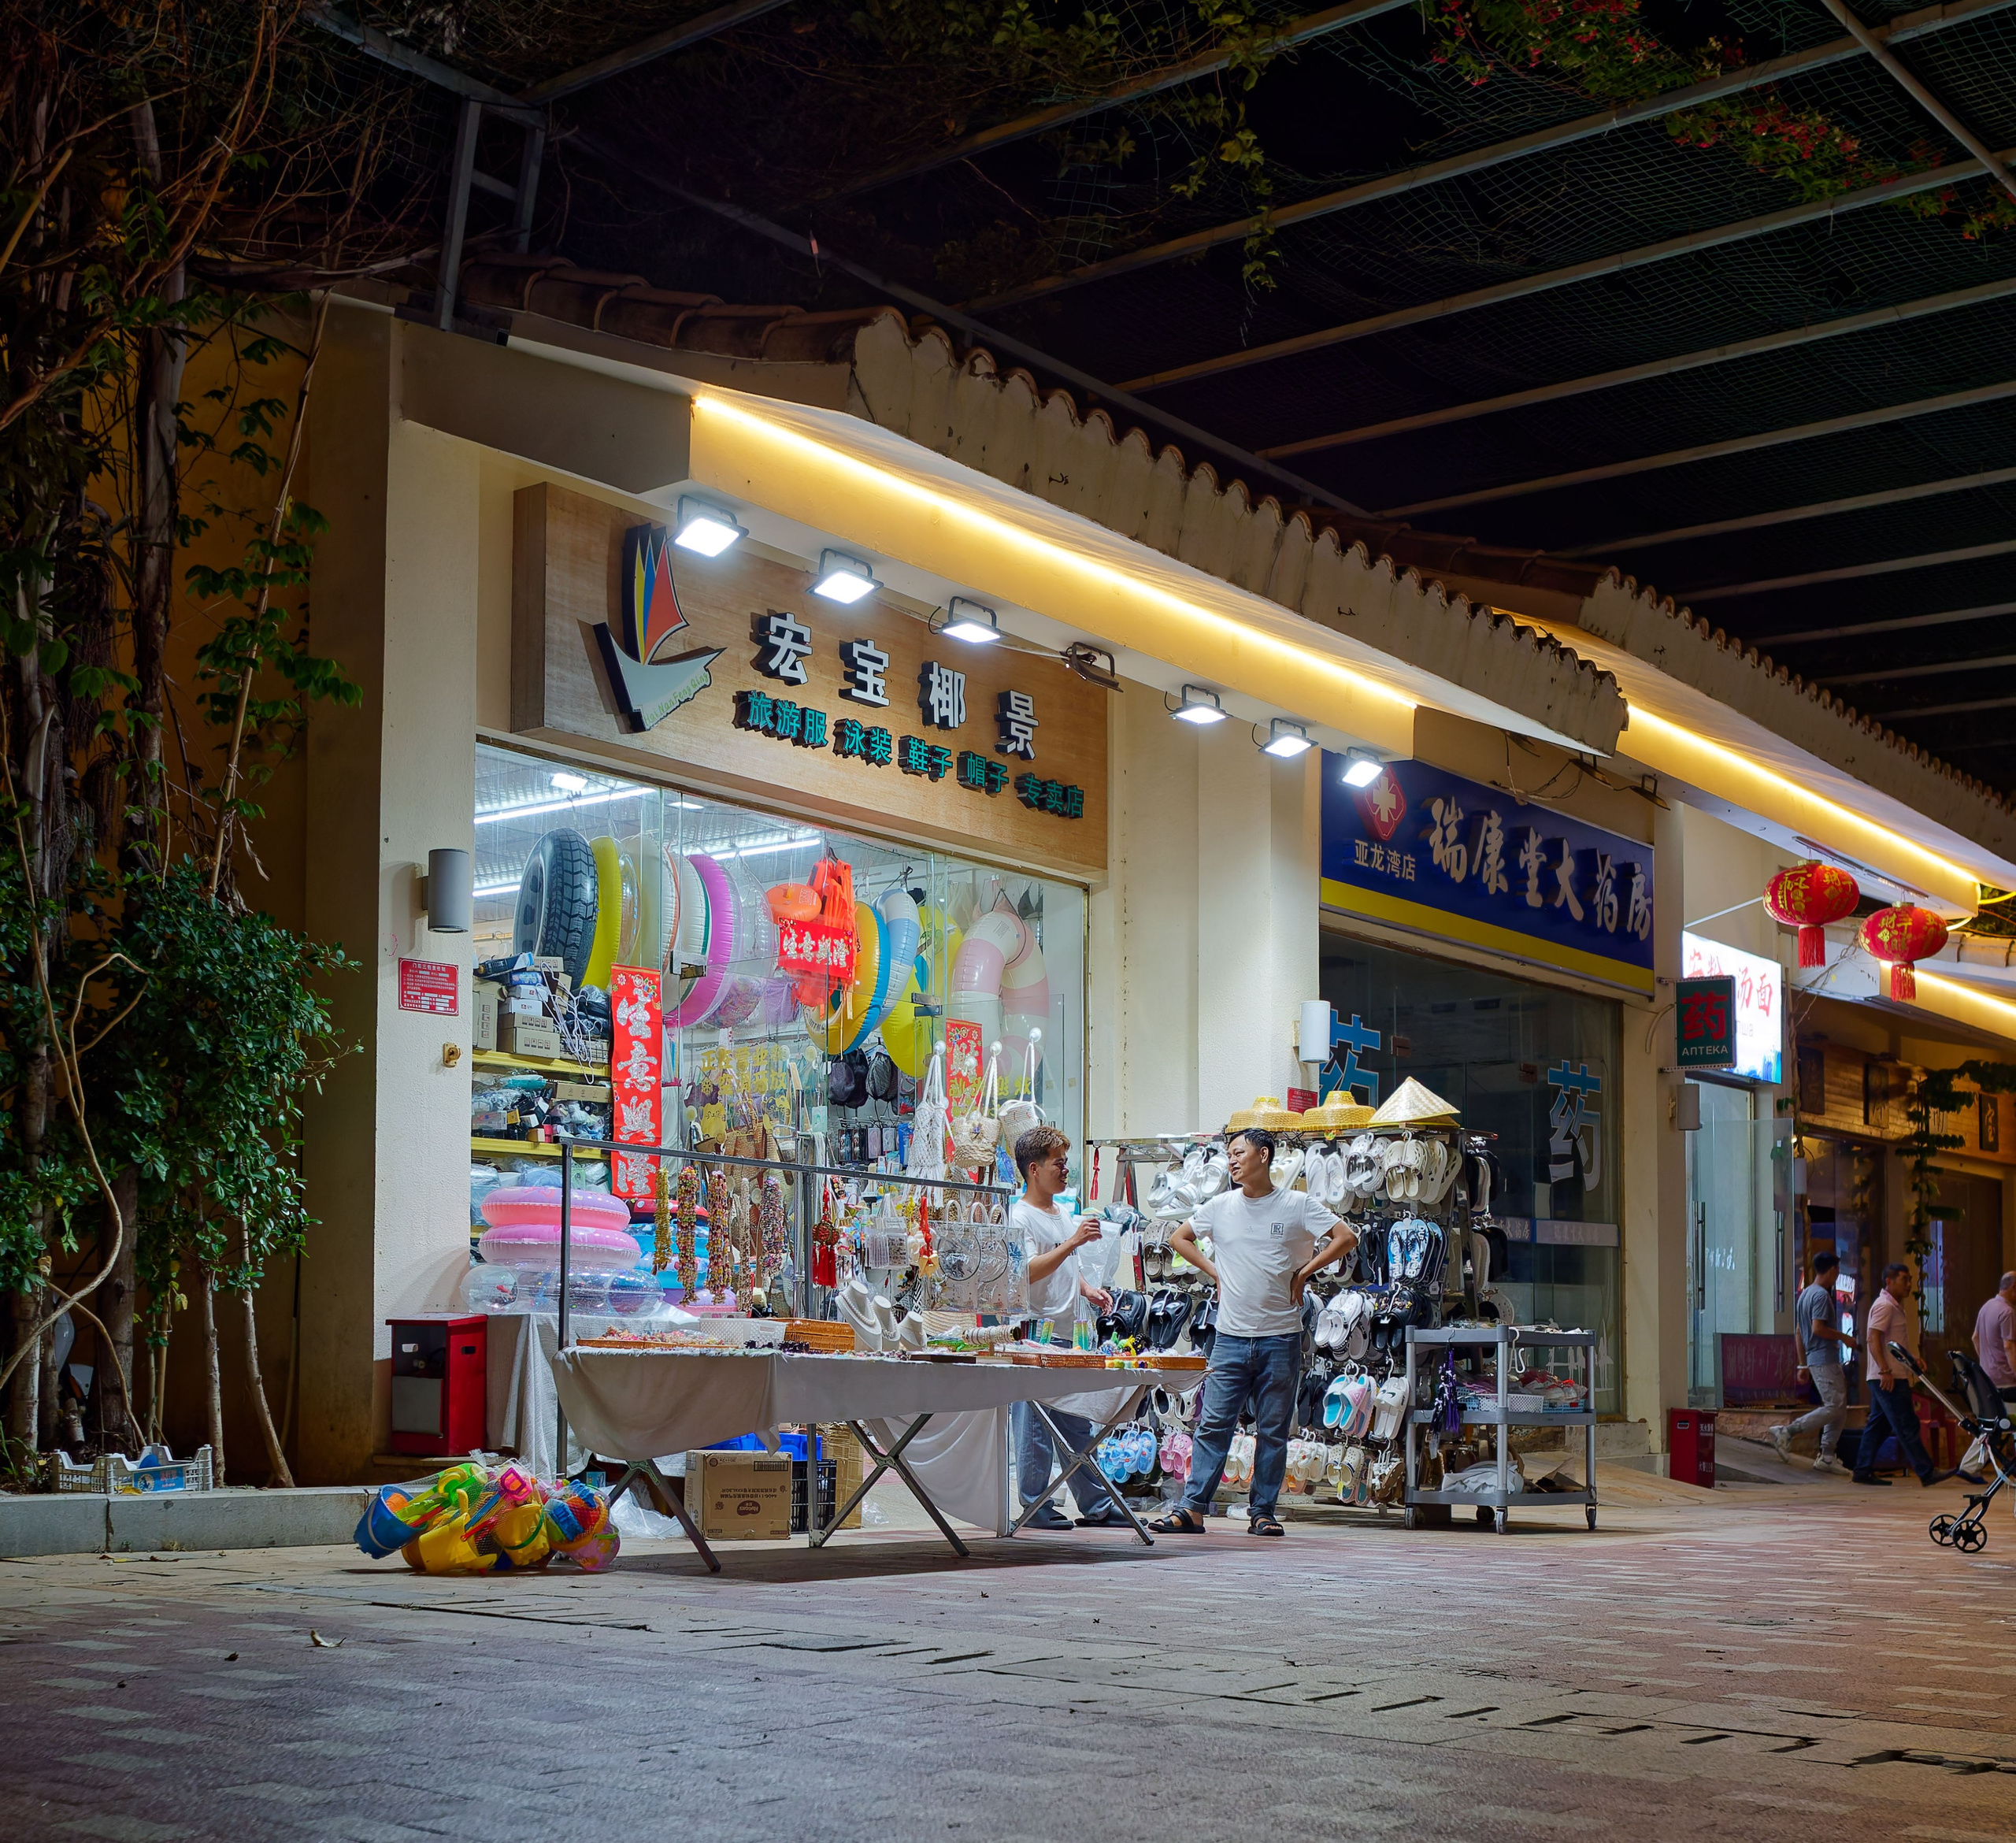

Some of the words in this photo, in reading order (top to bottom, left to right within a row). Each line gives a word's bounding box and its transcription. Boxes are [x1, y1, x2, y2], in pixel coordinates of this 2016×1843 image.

[765, 612, 1040, 761] 宏宝椰景
[748, 689, 828, 747] 旅游服
[844, 719, 893, 765] 泳装
[908, 737, 954, 778] 鞋子
[967, 754, 1009, 794] 帽子
[1024, 773, 1084, 818] 专卖店
[1354, 839, 1416, 882] 亚龙湾店
[1429, 795, 1652, 942] 瑞康堂大药房
[1680, 990, 1729, 1041] 药
[1681, 1044, 1729, 1056] АПТЕКА
[1547, 1059, 1603, 1192] 药
